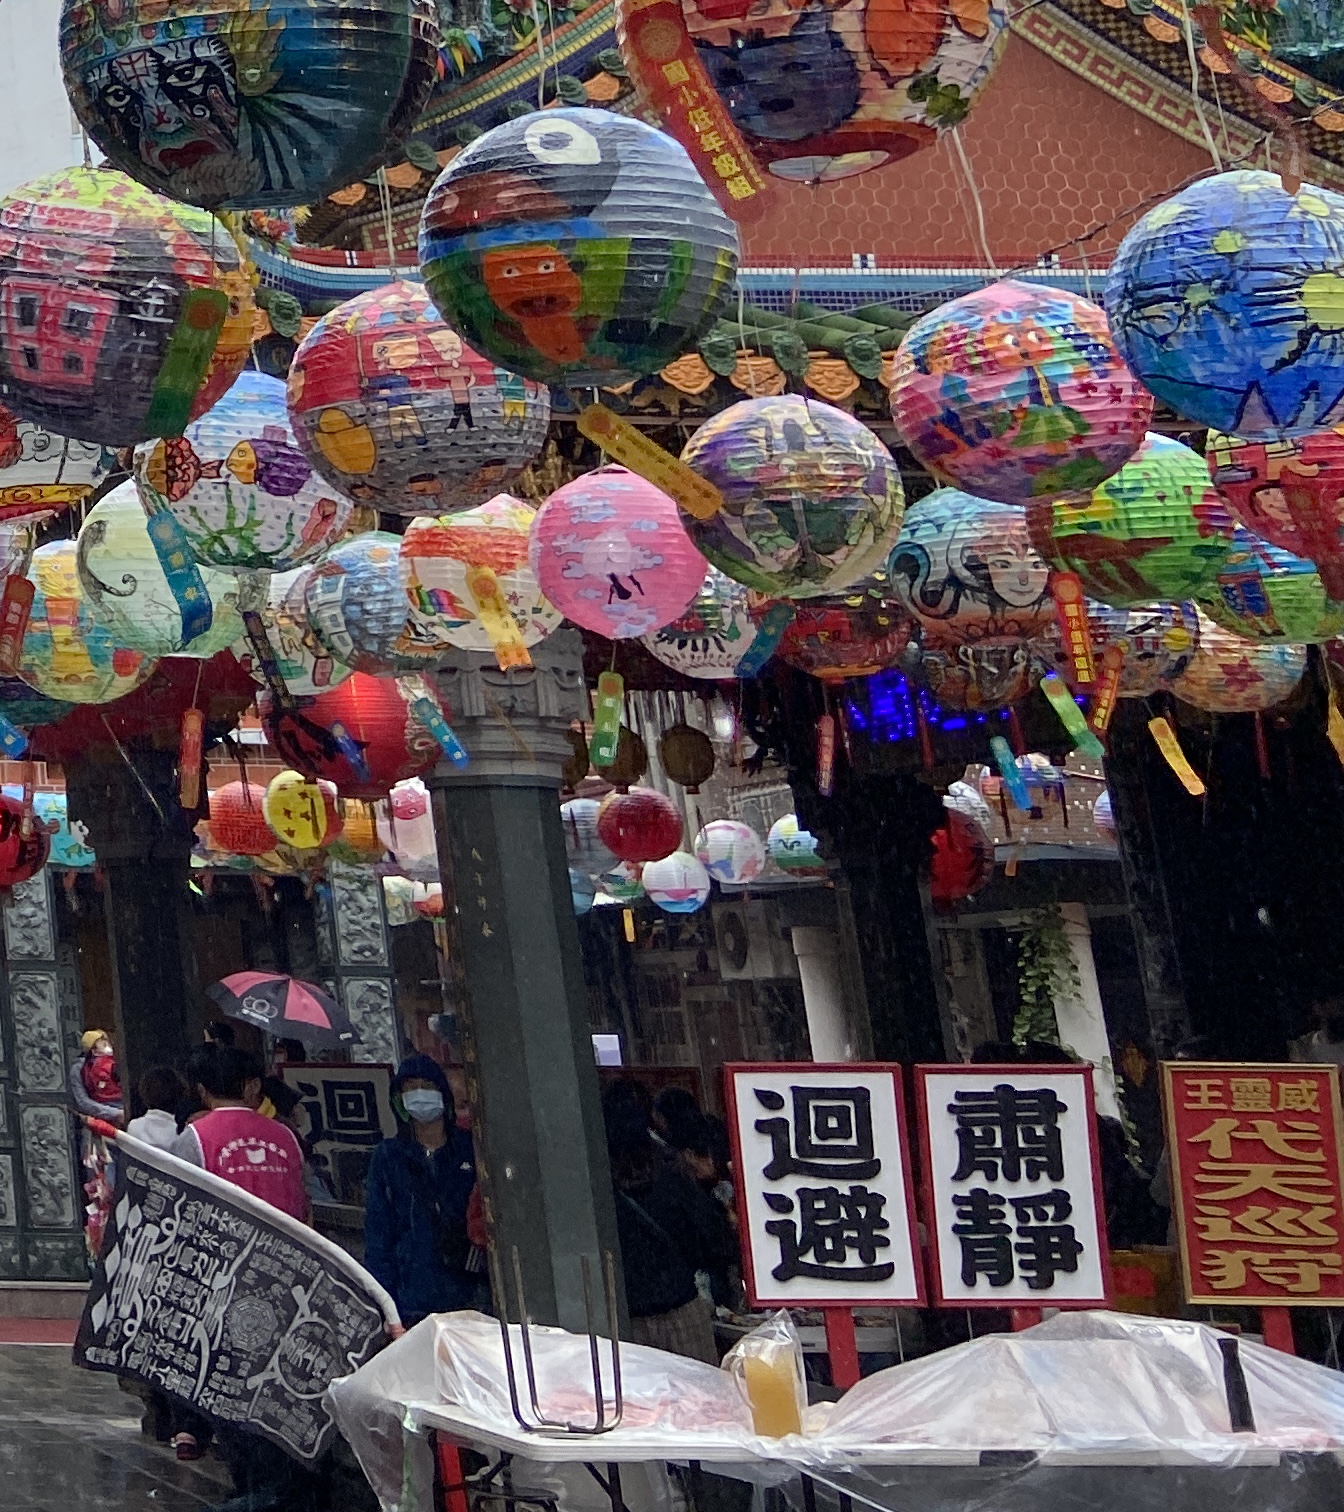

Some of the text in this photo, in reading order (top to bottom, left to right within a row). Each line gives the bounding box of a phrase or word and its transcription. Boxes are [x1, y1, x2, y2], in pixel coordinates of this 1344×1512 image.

[661, 58, 753, 202] 國小低年級組
[754, 1084, 895, 1283] 迴避
[946, 1083, 1084, 1291] 肅靜
[1186, 1118, 1343, 1294] 代天巡狩
